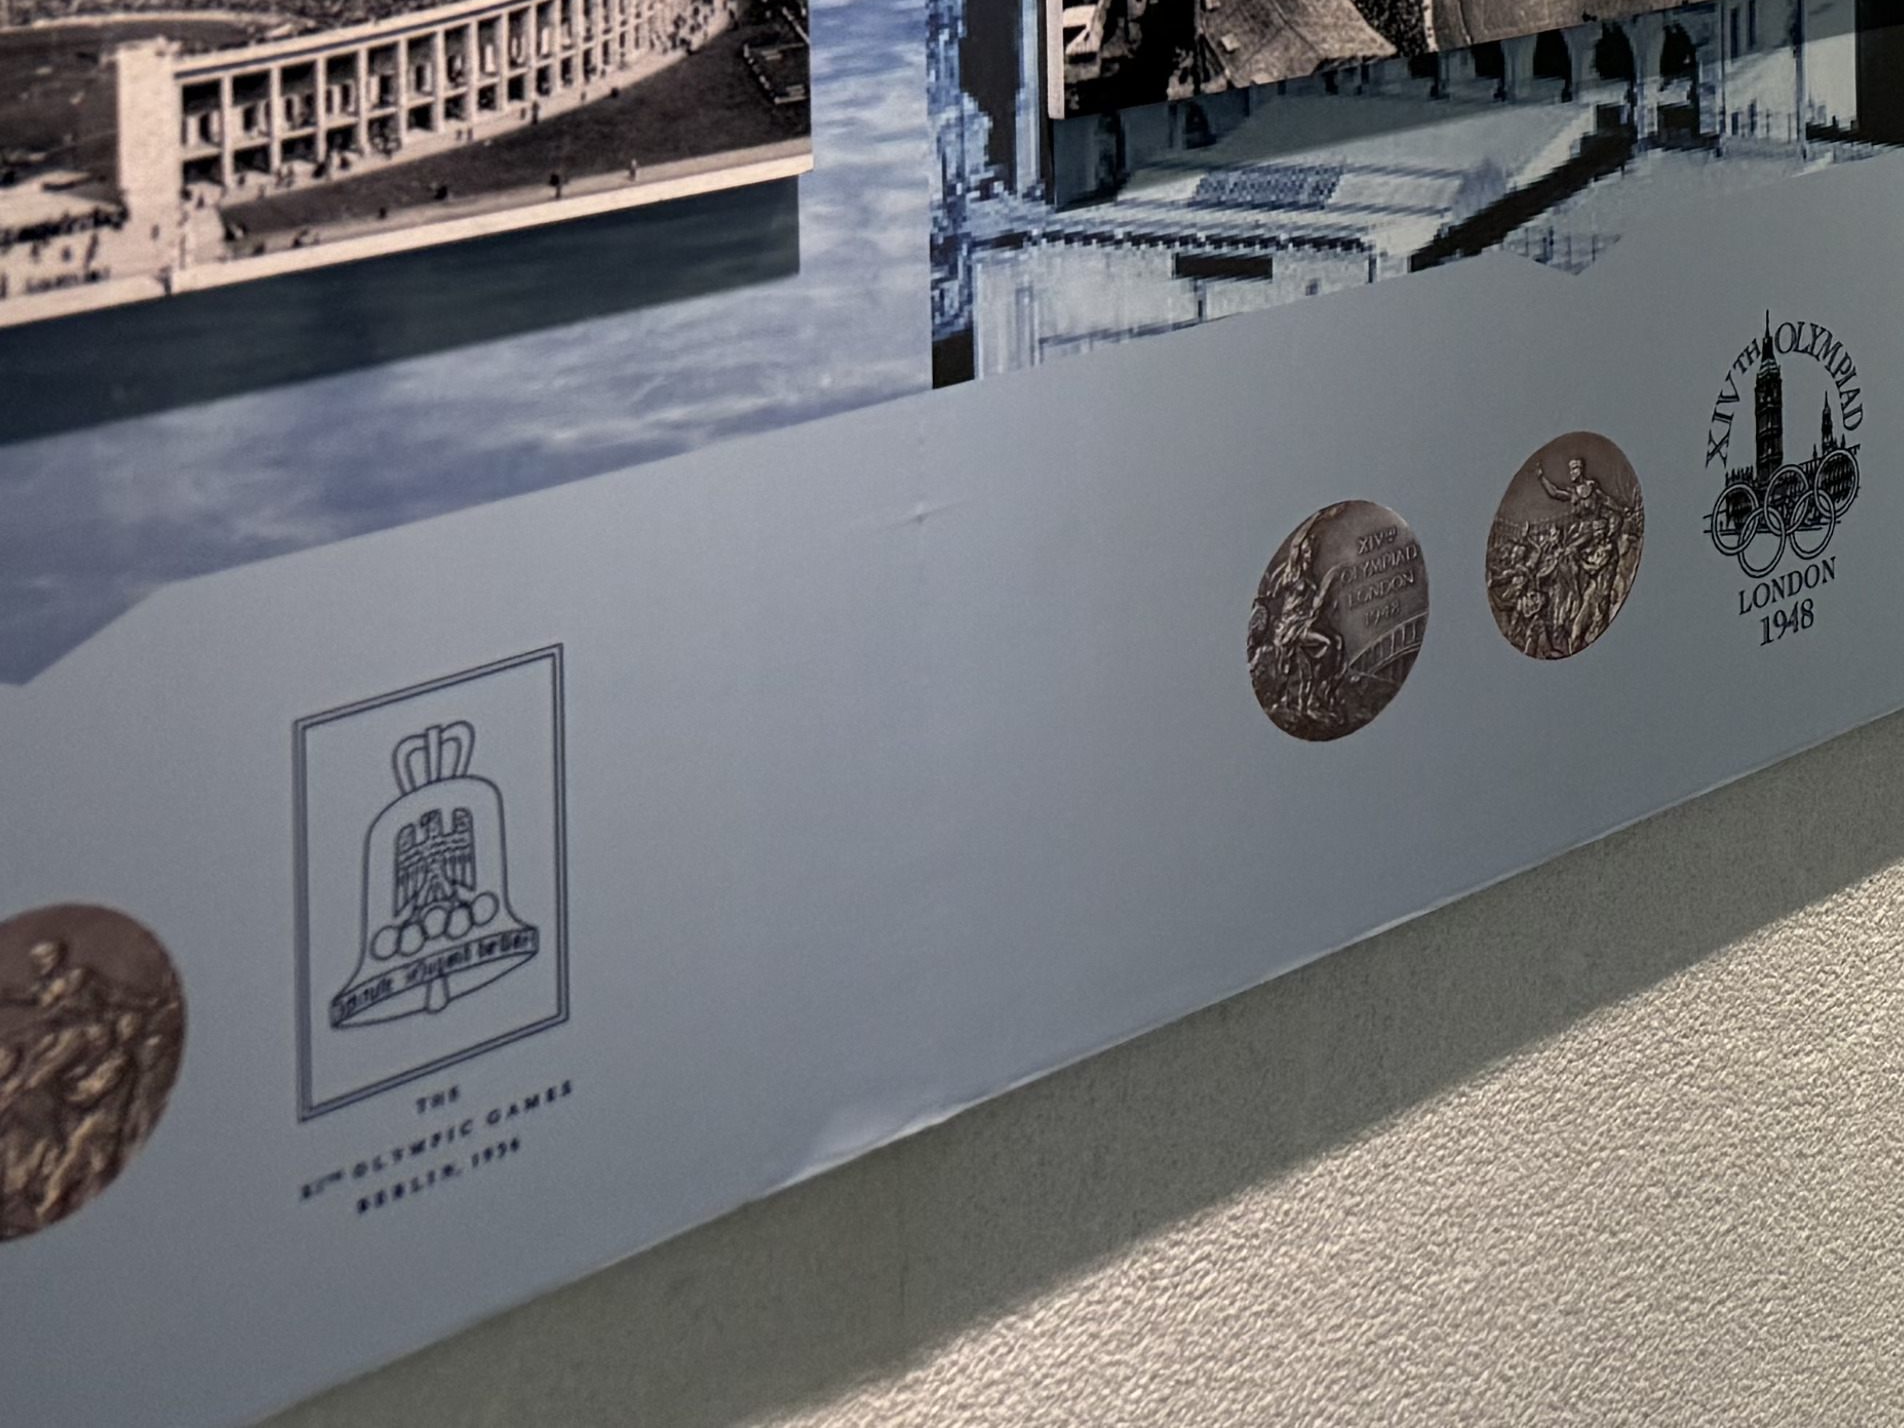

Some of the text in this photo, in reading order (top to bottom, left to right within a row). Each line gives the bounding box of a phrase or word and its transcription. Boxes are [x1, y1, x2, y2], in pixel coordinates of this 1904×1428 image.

[1774, 321, 1865, 432] OLYMPIAD
[1340, 543, 1418, 584] OLYMPIAD
[1737, 555, 1837, 616] LONDON
[1347, 570, 1415, 609] LONDON
[1759, 597, 1815, 647] 1948
[415, 1085, 461, 1115] THE
[351, 1079, 574, 1180] OLYMPIC GAMES
[470, 1137, 522, 1169] 1936
